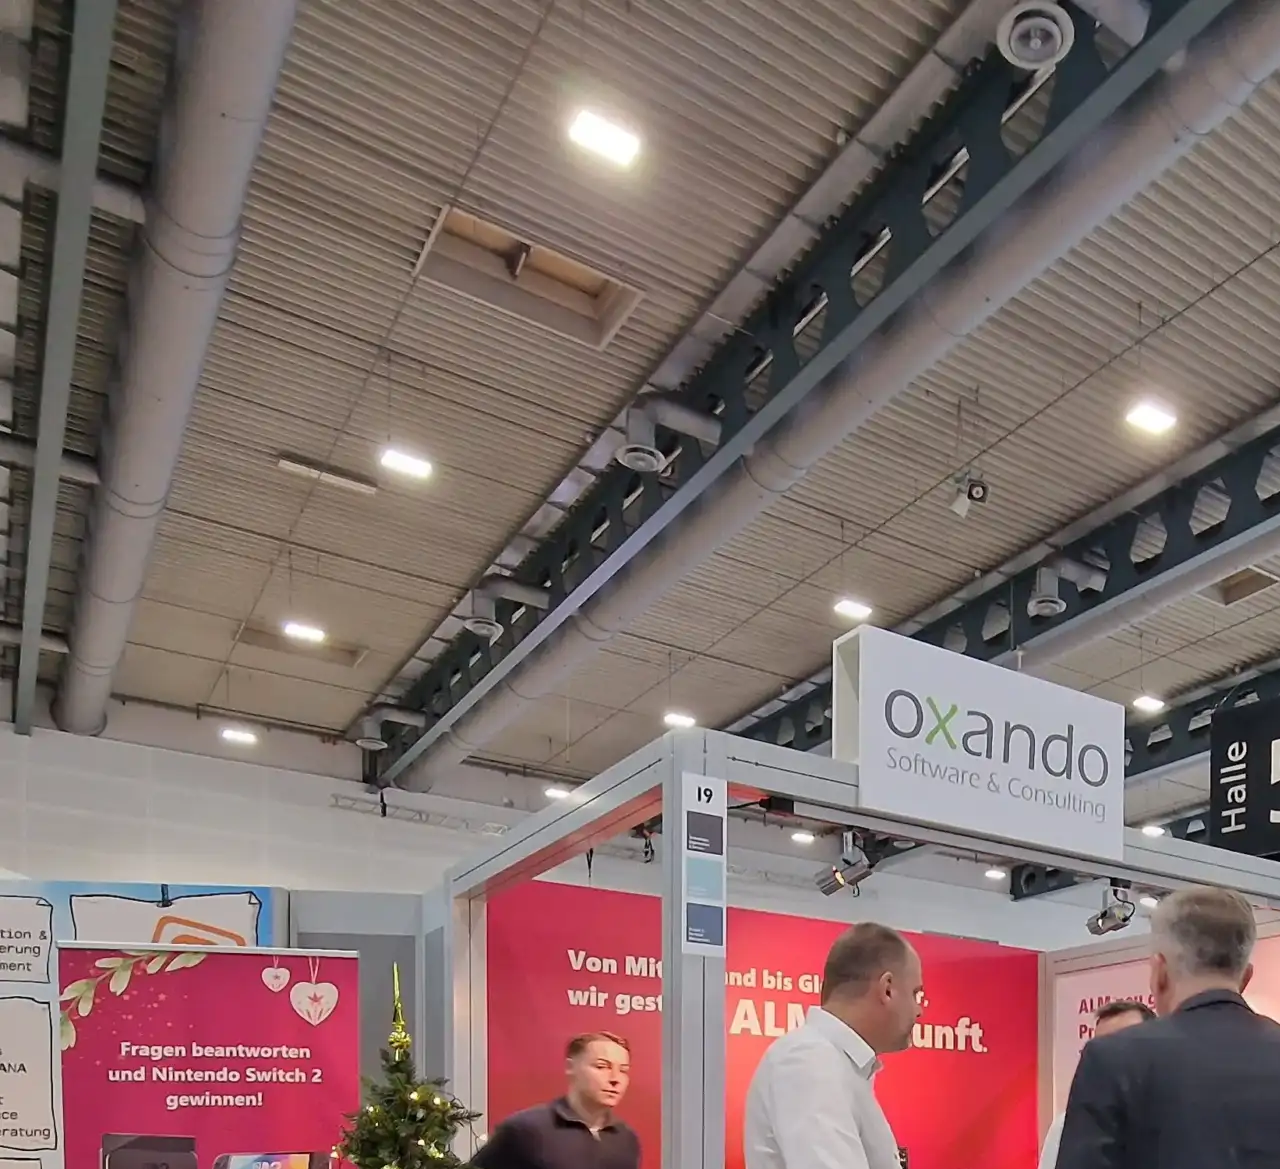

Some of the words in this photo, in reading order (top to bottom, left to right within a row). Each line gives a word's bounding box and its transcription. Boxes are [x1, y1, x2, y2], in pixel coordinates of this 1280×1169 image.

[884, 689, 1109, 787] oxando
[886, 746, 980, 789] Software
[987, 772, 1001, 794] &
[1008, 777, 1107, 823] Consulting
[1220, 741, 1247, 834] Halle
[39, 930, 48, 940] &
[567, 949, 618, 974] Von
[725, 968, 757, 988] nd
[763, 969, 793, 991] bis
[799, 974, 823, 994] Gl
[567, 985, 609, 1007] wir
[910, 1017, 988, 1053] unft.
[120, 1042, 186, 1060] Fragen
[192, 1042, 311, 1059] beantworten
[108, 1067, 146, 1082] und
[152, 1067, 241, 1082] Nintendo
[246, 1068, 306, 1083] Switch
[311, 1068, 323, 1083] 2
[0, 1111, 18, 1120] ce
[166, 1092, 263, 1110] gewinnen!
